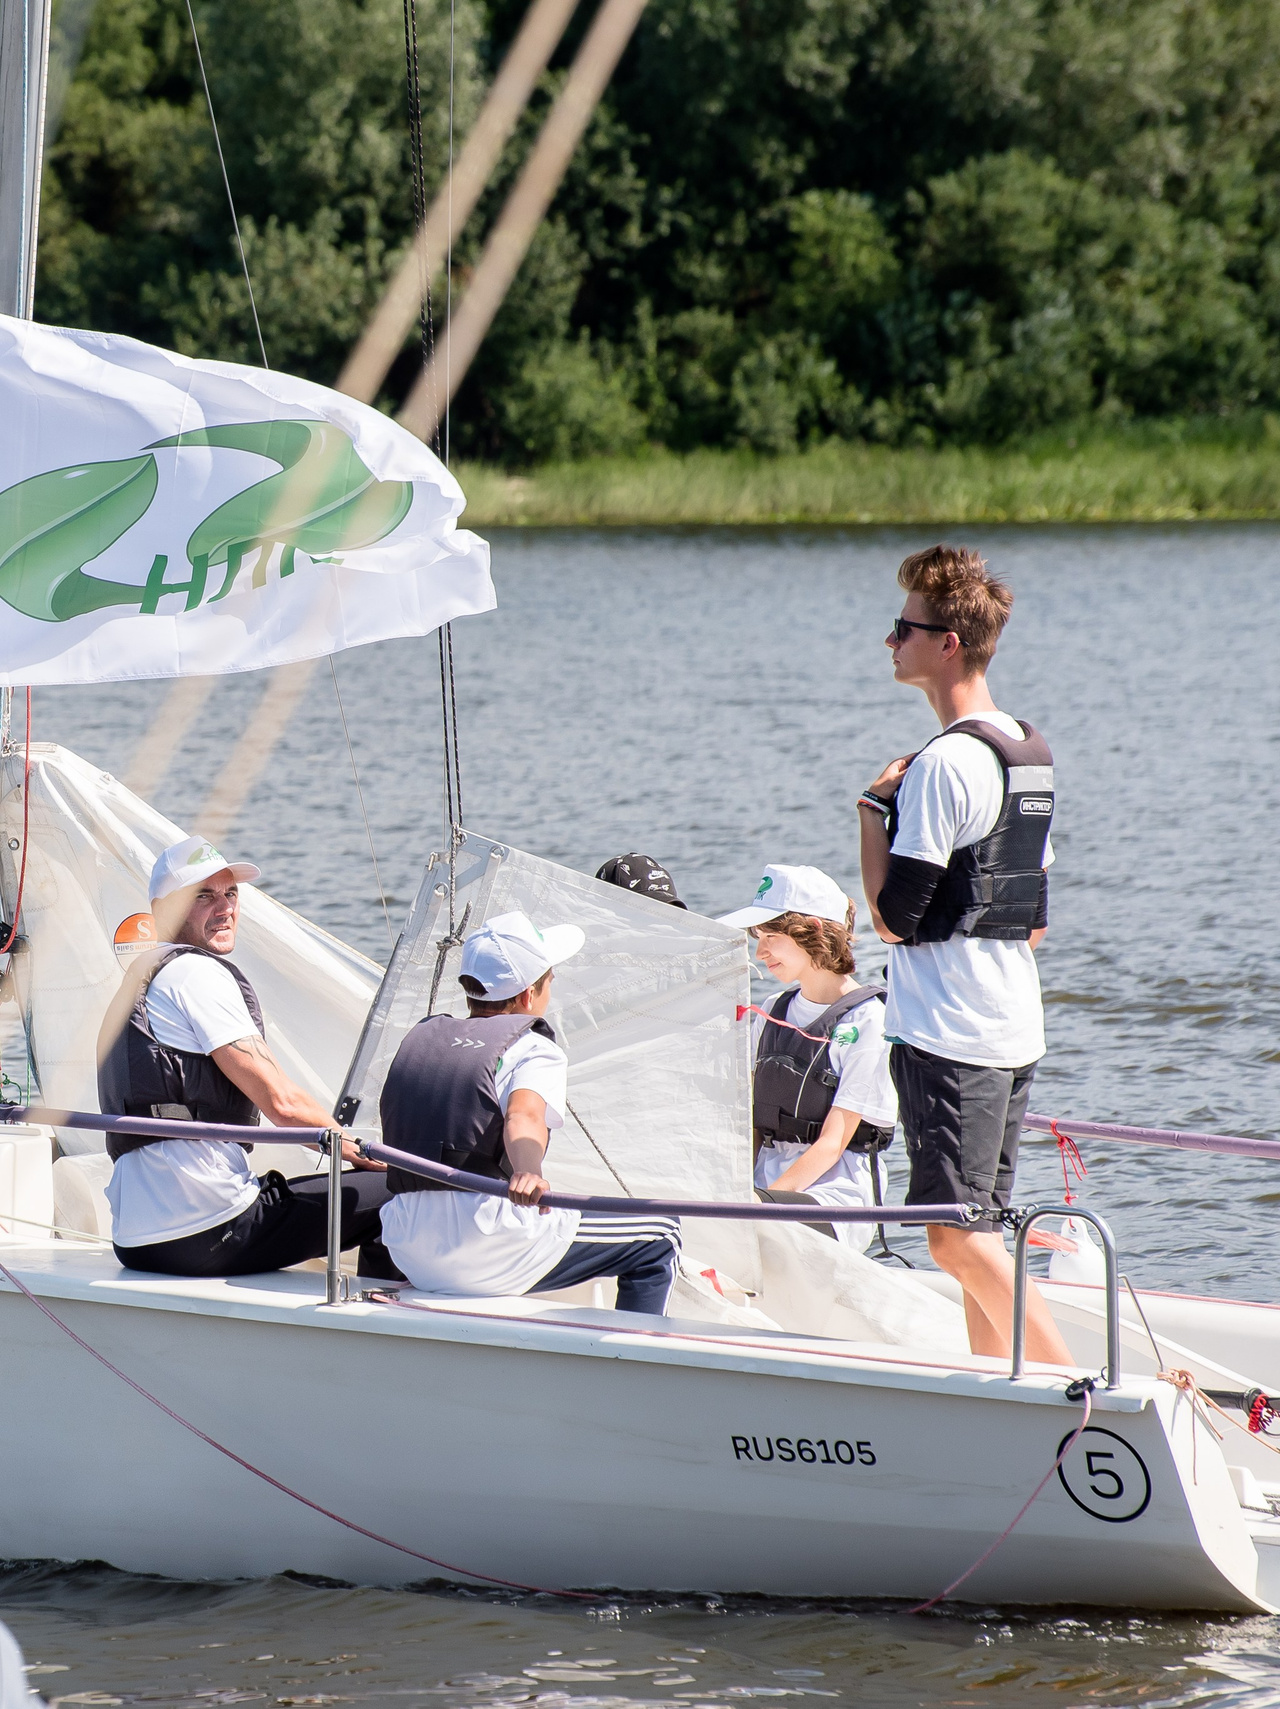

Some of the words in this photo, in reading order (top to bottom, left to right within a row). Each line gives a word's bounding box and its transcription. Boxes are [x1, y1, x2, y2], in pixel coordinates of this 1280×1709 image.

[221, 1230, 233, 1242] PRO
[730, 1434, 877, 1466] RUS6105
[1085, 1450, 1124, 1499] 5
